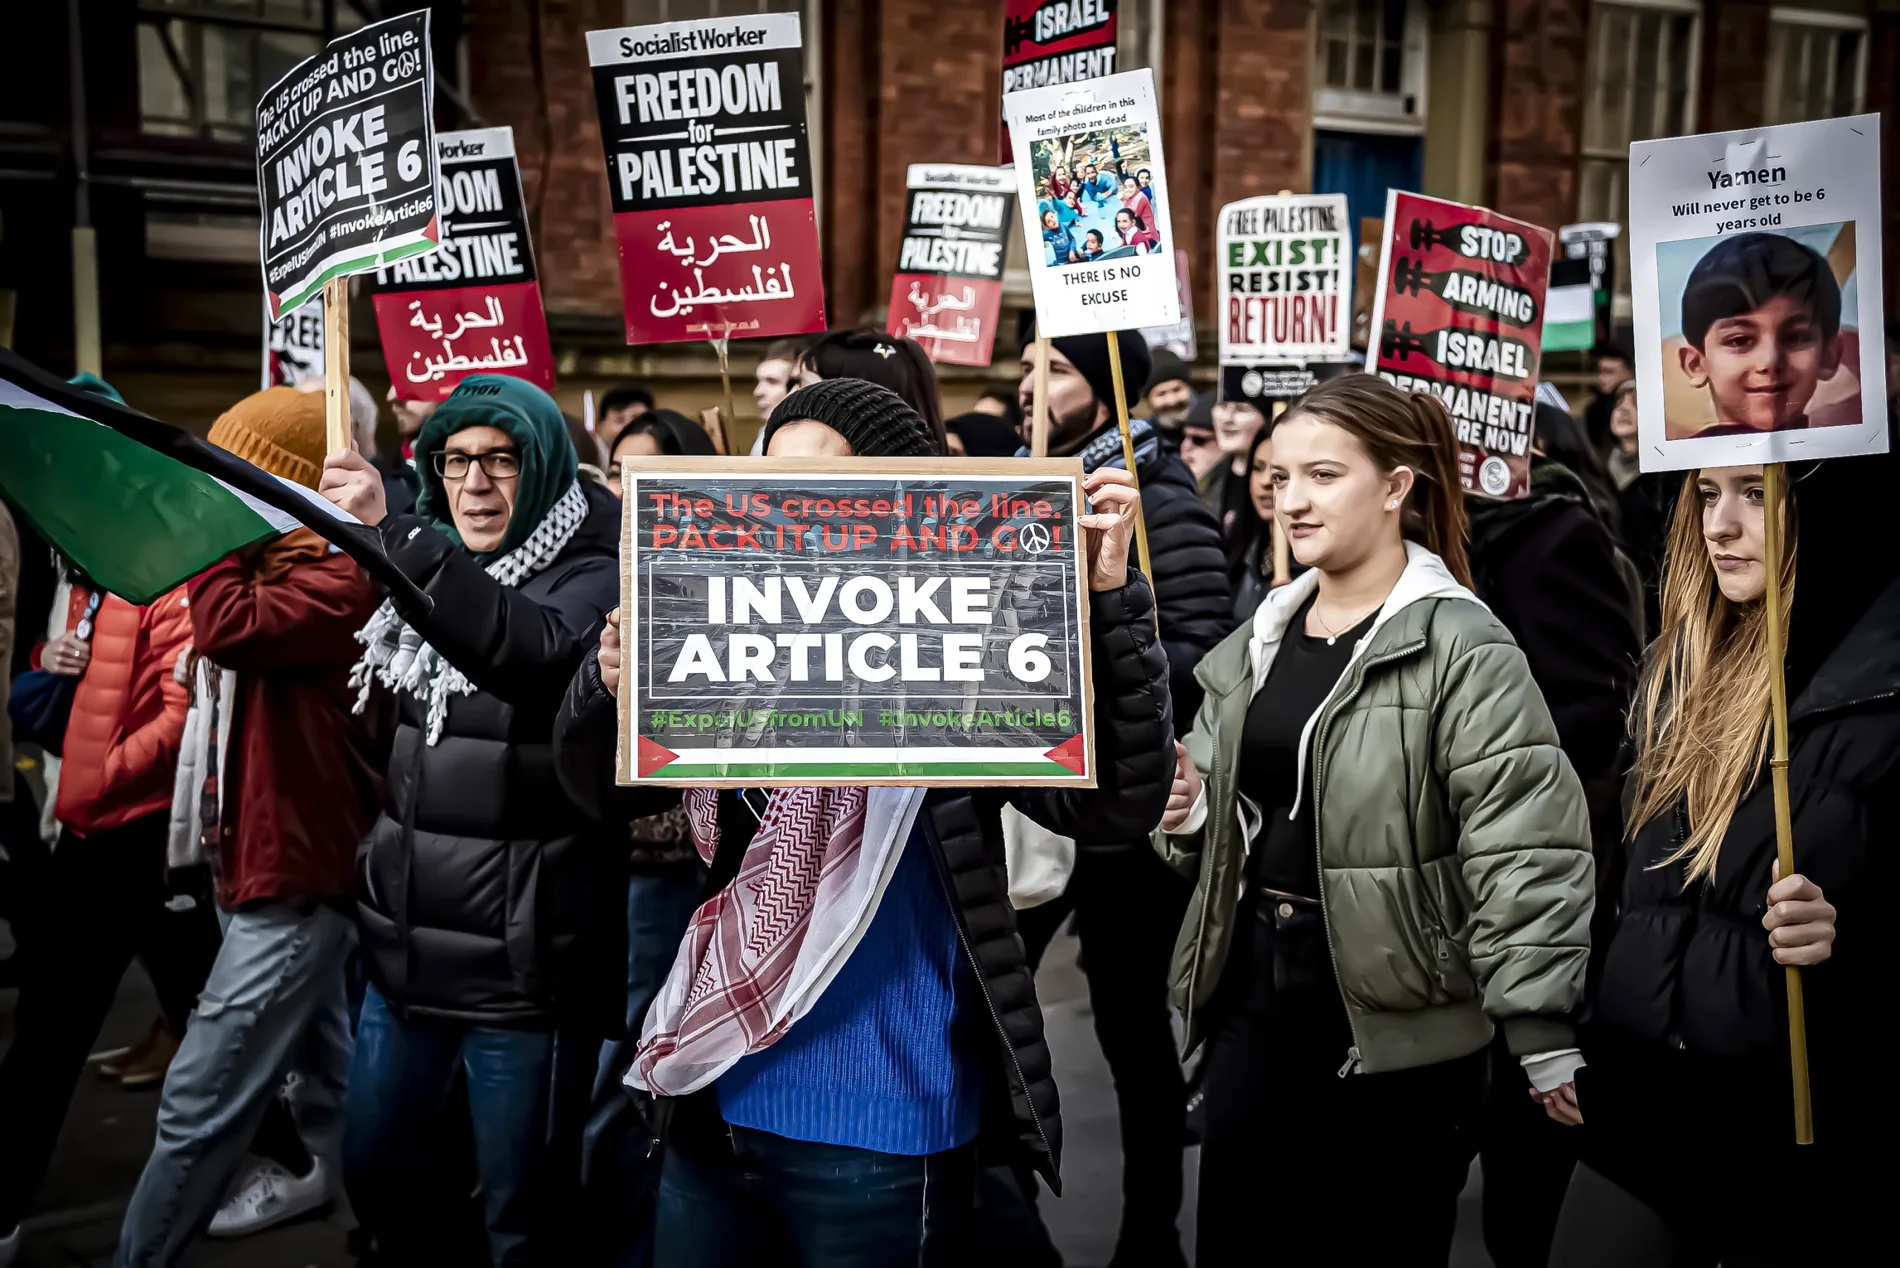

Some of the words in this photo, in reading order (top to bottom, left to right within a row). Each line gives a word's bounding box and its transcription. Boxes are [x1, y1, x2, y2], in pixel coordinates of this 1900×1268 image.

[1035, 0, 1110, 42] ISRAEL
[619, 31, 697, 58] Socialist
[697, 26, 768, 50] Worker
[258, 106, 274, 131] The
[276, 87, 290, 114] US
[291, 52, 339, 100] crossed
[343, 44, 376, 70] the
[379, 30, 420, 57] line.
[1003, 46, 1116, 93] PERMANENT
[258, 112, 290, 157] PACK
[289, 101, 300, 130] IT
[302, 87, 323, 117] UP
[326, 67, 376, 104] AND
[614, 61, 782, 124] FREEDOM
[1025, 112, 1046, 124] Most
[1048, 108, 1056, 119] of
[1058, 107, 1070, 118] the
[1072, 101, 1106, 116] children
[1108, 100, 1118, 110] in
[1119, 97, 1136, 108] this
[688, 118, 716, 144] for
[1037, 124, 1061, 137] family
[1062, 121, 1087, 134] photo
[1089, 120, 1102, 128] are
[1104, 114, 1127, 126] dead
[276, 104, 388, 200] INVOKE
[616, 138, 800, 201] PALESTINE
[270, 152, 388, 249] ARTICLE
[397, 139, 422, 182] 6
[1707, 166, 1786, 190] Yamen
[329, 194, 434, 239] #InvokeArticle6
[911, 191, 1005, 229] FREEDOM
[1227, 207, 1258, 236] FREE
[1263, 205, 1338, 234] PALESTINE
[1672, 202, 1700, 216] Will
[1703, 198, 1746, 214] never
[1750, 194, 1772, 210] get
[1774, 194, 1790, 205] to
[1794, 190, 1812, 203] be
[1816, 188, 1826, 200] 6
[656, 214, 772, 267] الحرية
[1716, 218, 1757, 234] years
[1760, 213, 1782, 226] old
[900, 237, 1003, 276] PALESTINE
[1228, 238, 1340, 268] EXIST!
[1460, 224, 1522, 263] STOP
[650, 262, 795, 318] لفلسطين
[1062, 270, 1100, 286] THERE
[1103, 268, 1116, 281] IS
[1120, 265, 1141, 279] NO
[1229, 270, 1339, 293] RESIST!
[1081, 289, 1128, 306] EXCUSE
[1442, 272, 1534, 323] ARMING
[410, 295, 504, 341] الحرية
[1229, 294, 1339, 345] RETURN!
[406, 334, 528, 383] لفلسطين
[1436, 330, 1530, 379] ISRAEL
[1484, 426, 1528, 456] NOW
[648, 493, 715, 518] The
[726, 493, 771, 518] US
[781, 493, 913, 518] crossed
[923, 493, 981, 518] the
[991, 492, 1062, 518] line.
[653, 524, 763, 551] PACK
[776, 524, 810, 551] IT
[822, 524, 878, 551] UP
[890, 524, 980, 552] AND
[707, 576, 993, 626] INVOKE
[668, 632, 986, 684] ARTICLE
[1008, 632, 1052, 684] 6
[880, 708, 1072, 728] #InvokeArticle6
